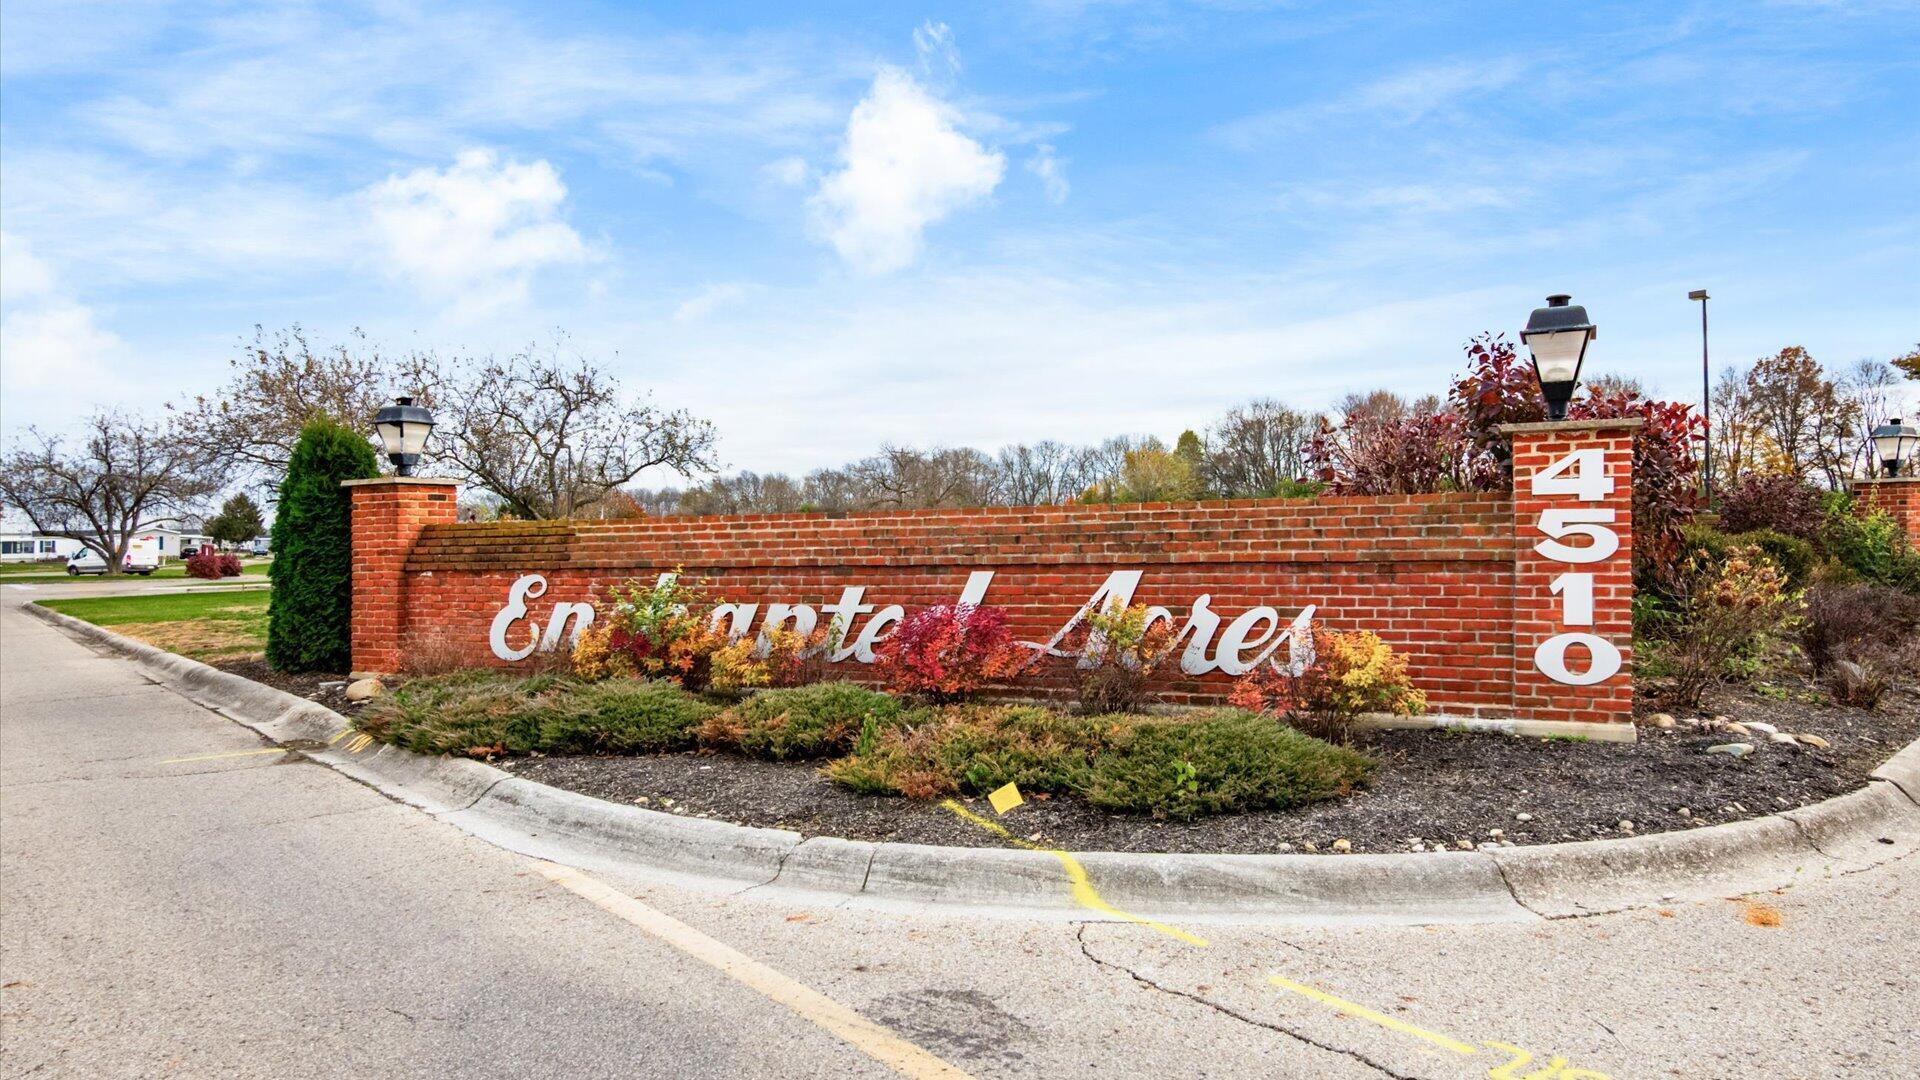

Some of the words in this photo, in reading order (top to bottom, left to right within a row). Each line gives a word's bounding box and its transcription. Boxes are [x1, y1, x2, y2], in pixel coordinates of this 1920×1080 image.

[489, 571, 996, 664] Enante
[1010, 570, 1316, 678] Acres
[1532, 448, 1622, 685] 4510
